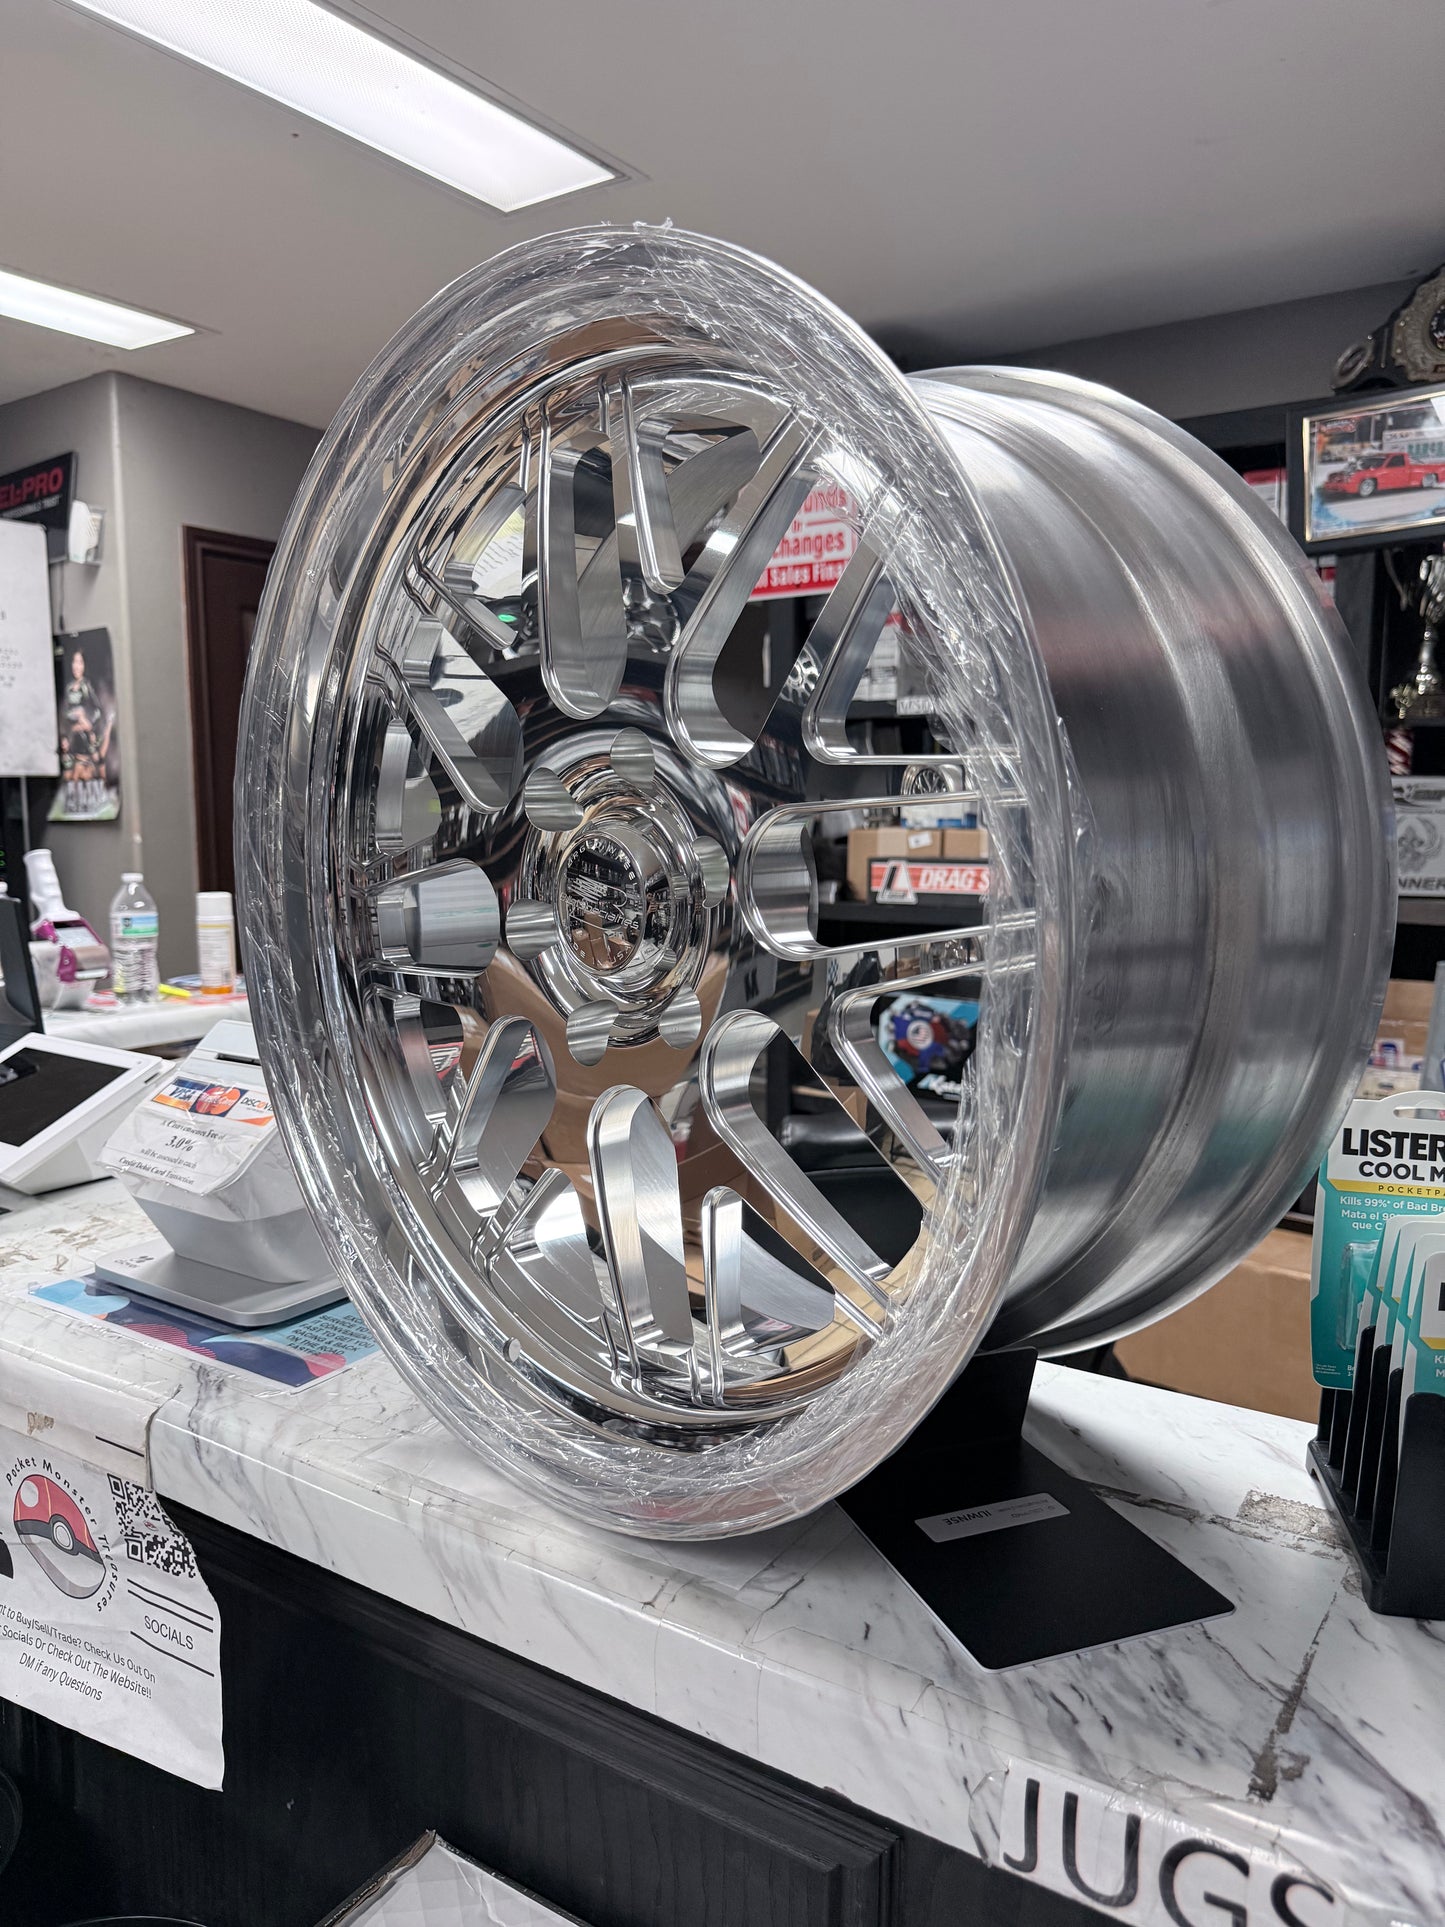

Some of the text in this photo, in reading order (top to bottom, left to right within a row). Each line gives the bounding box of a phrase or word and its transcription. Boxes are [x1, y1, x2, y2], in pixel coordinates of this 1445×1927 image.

[770, 565, 810, 587] Sales
[918, 868, 977, 890] DRAG
[1359, 1160, 1425, 1182] COOL
[1378, 1184, 1445, 1197] POCKETP
[1340, 1196, 1362, 1206] Kills
[1393, 1200, 1405, 1209] of
[1407, 1202, 1428, 1211] Bad
[1341, 1209, 1367, 1220] Mata
[1369, 1211, 1380, 1221] el
[1351, 1222, 1373, 1231] que
[43, 1459, 98, 1526] Monster
[144, 1614, 194, 1650] SOCIALS
[7, 1607, 16, 1620] to
[84, 1641, 112, 1662] Check
[113, 1652, 126, 1666] Us
[127, 1658, 143, 1677] Out
[143, 1668, 156, 1684] On
[2, 1624, 152, 1699] Socials Or Check Out The Website!!
[19, 1652, 103, 1701] DM if any Questions
